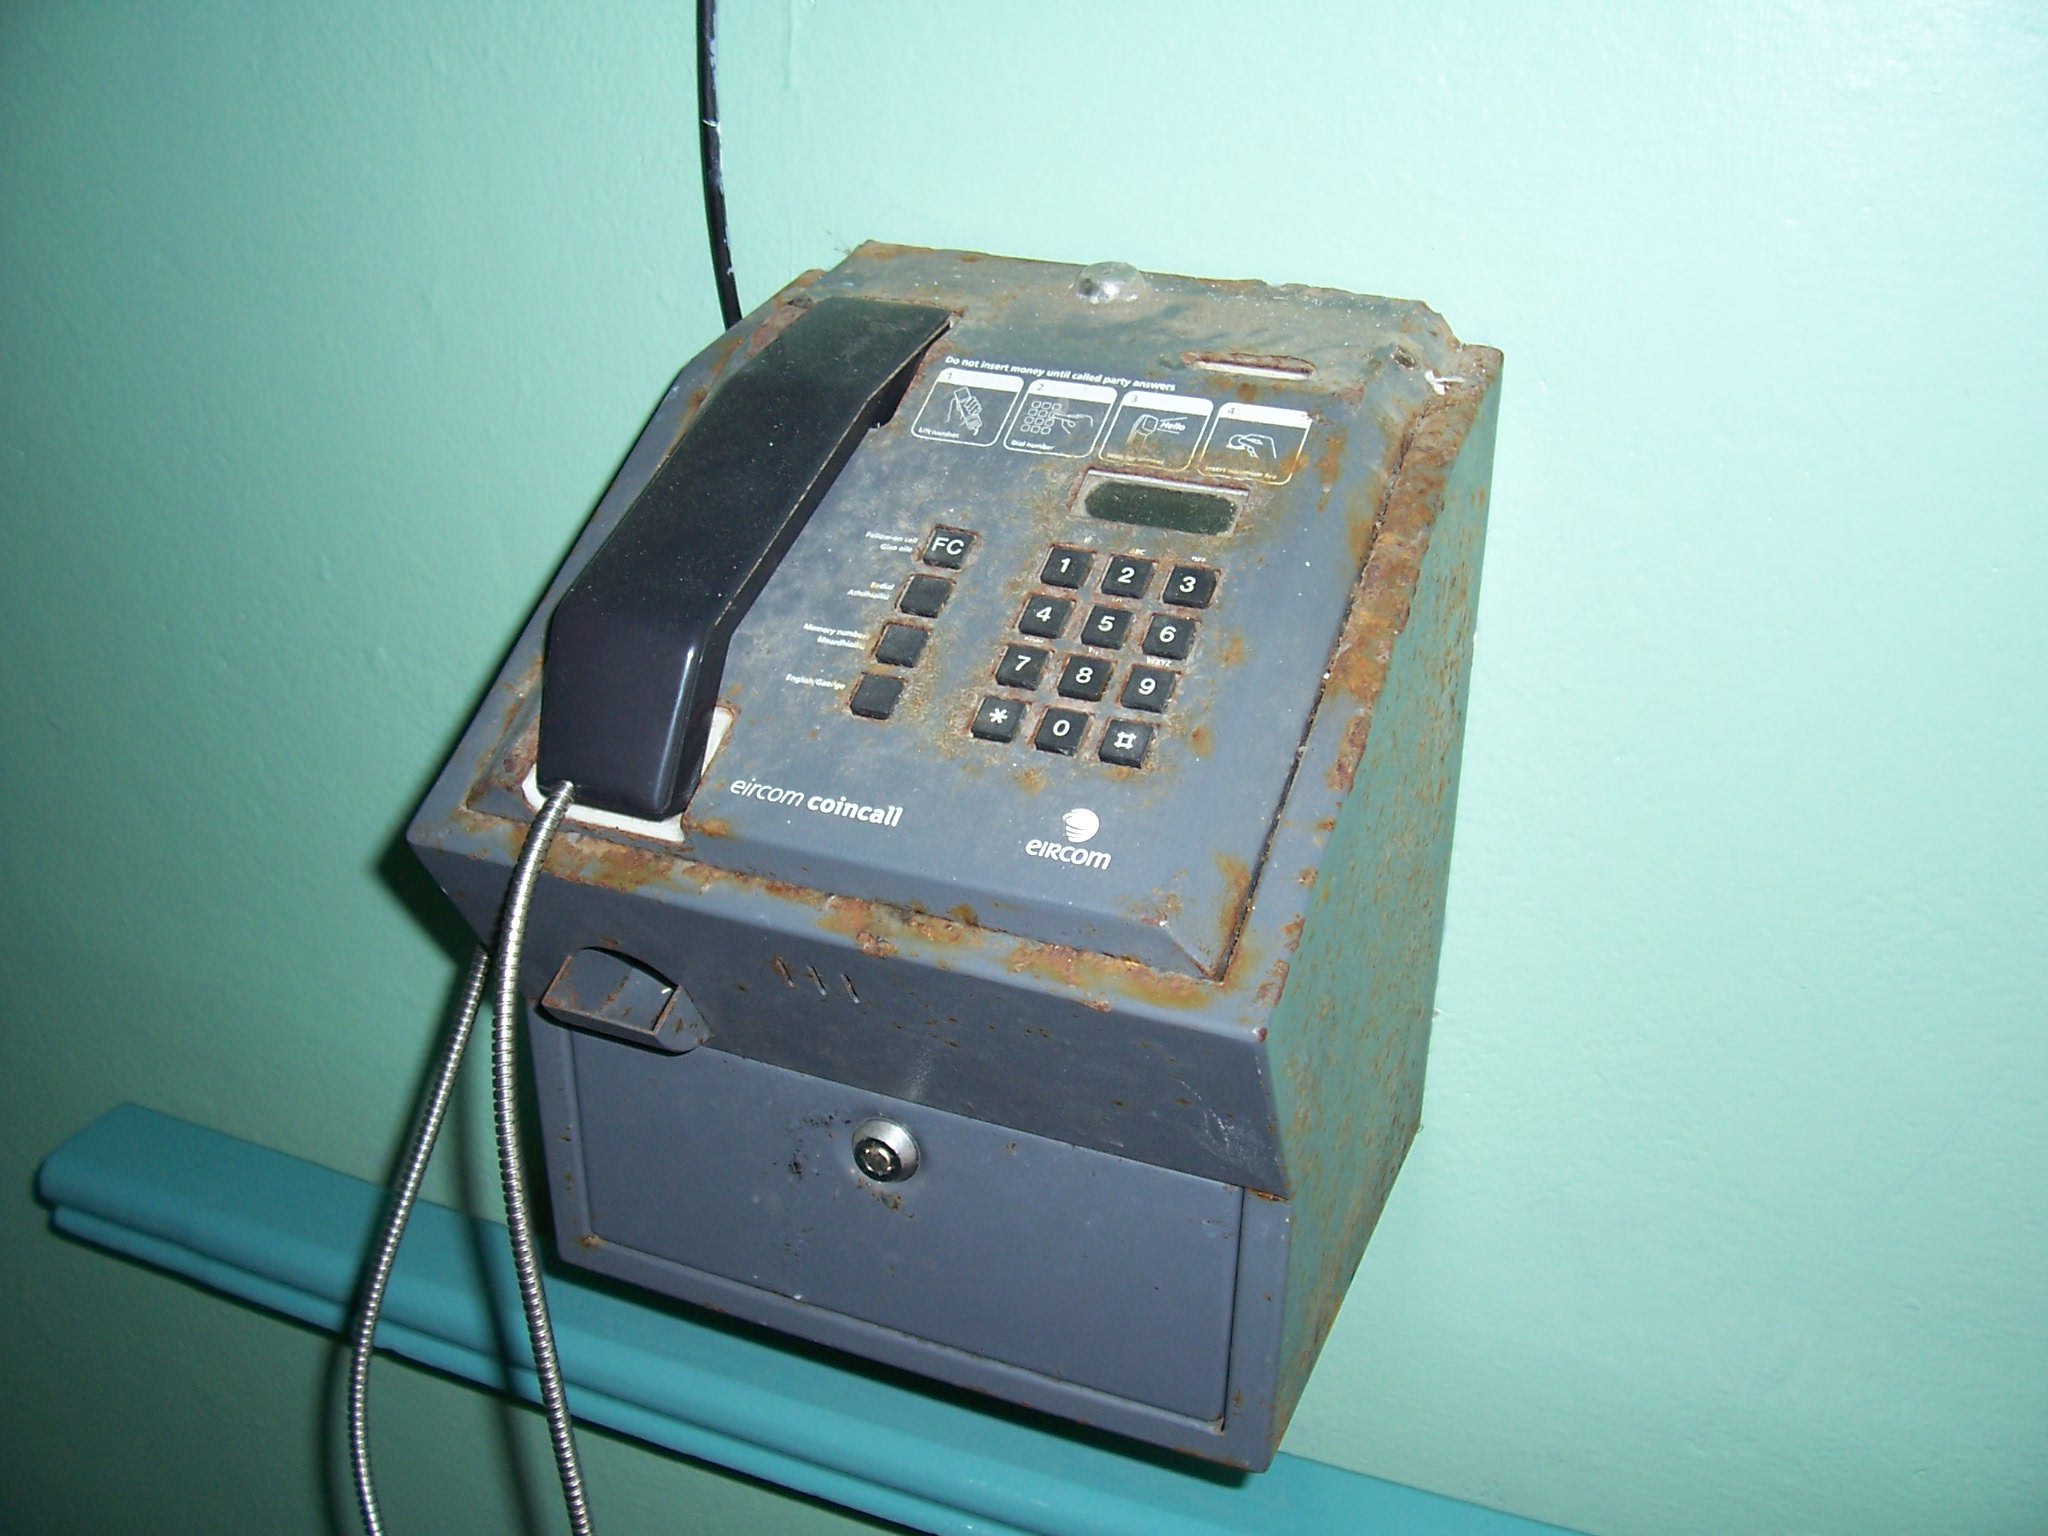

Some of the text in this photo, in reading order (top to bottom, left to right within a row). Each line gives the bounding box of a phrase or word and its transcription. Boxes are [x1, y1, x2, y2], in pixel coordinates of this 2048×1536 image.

[945, 355, 1176, 391] Do not insert money until called party answers
[1160, 421, 1186, 431] Hello
[1010, 439, 1055, 450] Dial number
[931, 536, 965, 556] FC
[1059, 557, 1071, 574] 1
[1117, 566, 1135, 584] 2
[1179, 575, 1197, 593] 3
[1035, 606, 1053, 622] 4
[803, 622, 870, 640] Memory number
[1097, 615, 1116, 632] 5
[1159, 625, 1177, 643] 6
[1013, 655, 1032, 671] 7
[1075, 666, 1094, 684] 8
[1138, 677, 1156, 695] 9
[1052, 719, 1071, 737] 0
[730, 777, 904, 828] eircom coincall
